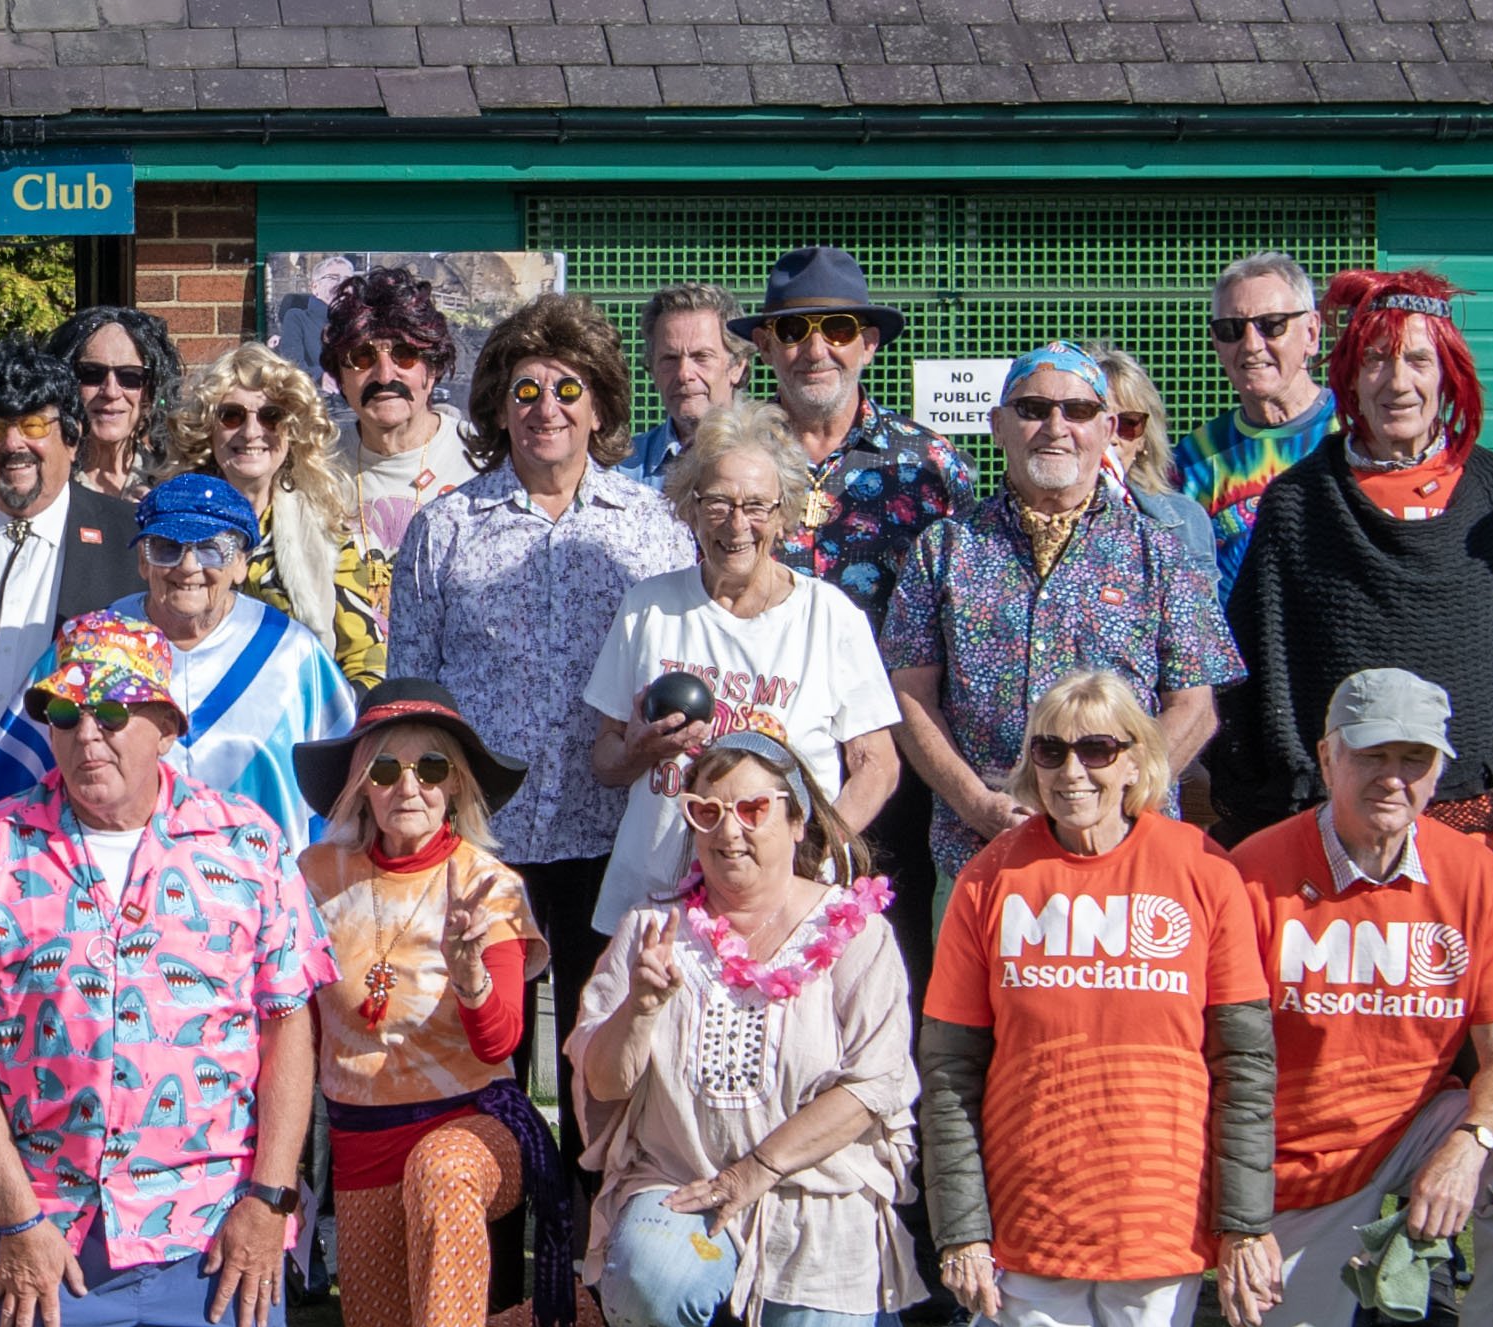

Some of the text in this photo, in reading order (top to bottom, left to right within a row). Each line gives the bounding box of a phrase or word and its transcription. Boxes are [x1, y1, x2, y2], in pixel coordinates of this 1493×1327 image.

[13, 172, 113, 211] Club
[951, 372, 974, 383] NO
[933, 392, 991, 403] PUBLIC
[109, 632, 138, 649] LOVE
[723, 671, 750, 702] IS
[752, 673, 797, 709] MY
[1000, 892, 1191, 960] MND
[1280, 918, 1470, 988] MND
[1001, 960, 1188, 995] Association
[1279, 986, 1466, 1019] Association
